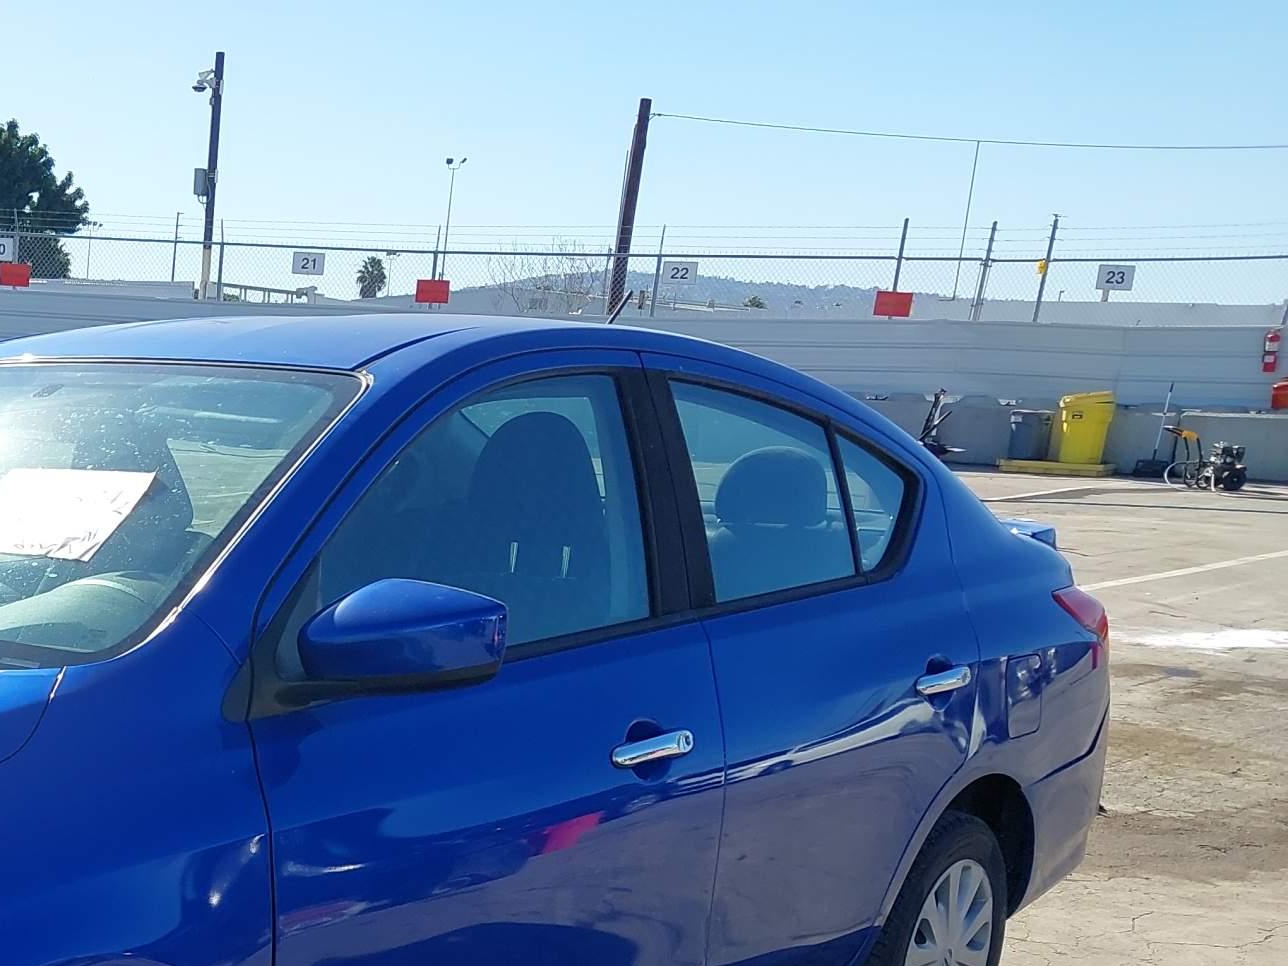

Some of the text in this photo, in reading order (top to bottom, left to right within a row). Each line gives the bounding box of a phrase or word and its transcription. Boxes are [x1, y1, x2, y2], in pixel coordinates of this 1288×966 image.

[300, 257, 317, 270] 21
[670, 266, 689, 280] 22
[1105, 270, 1125, 285] 23
